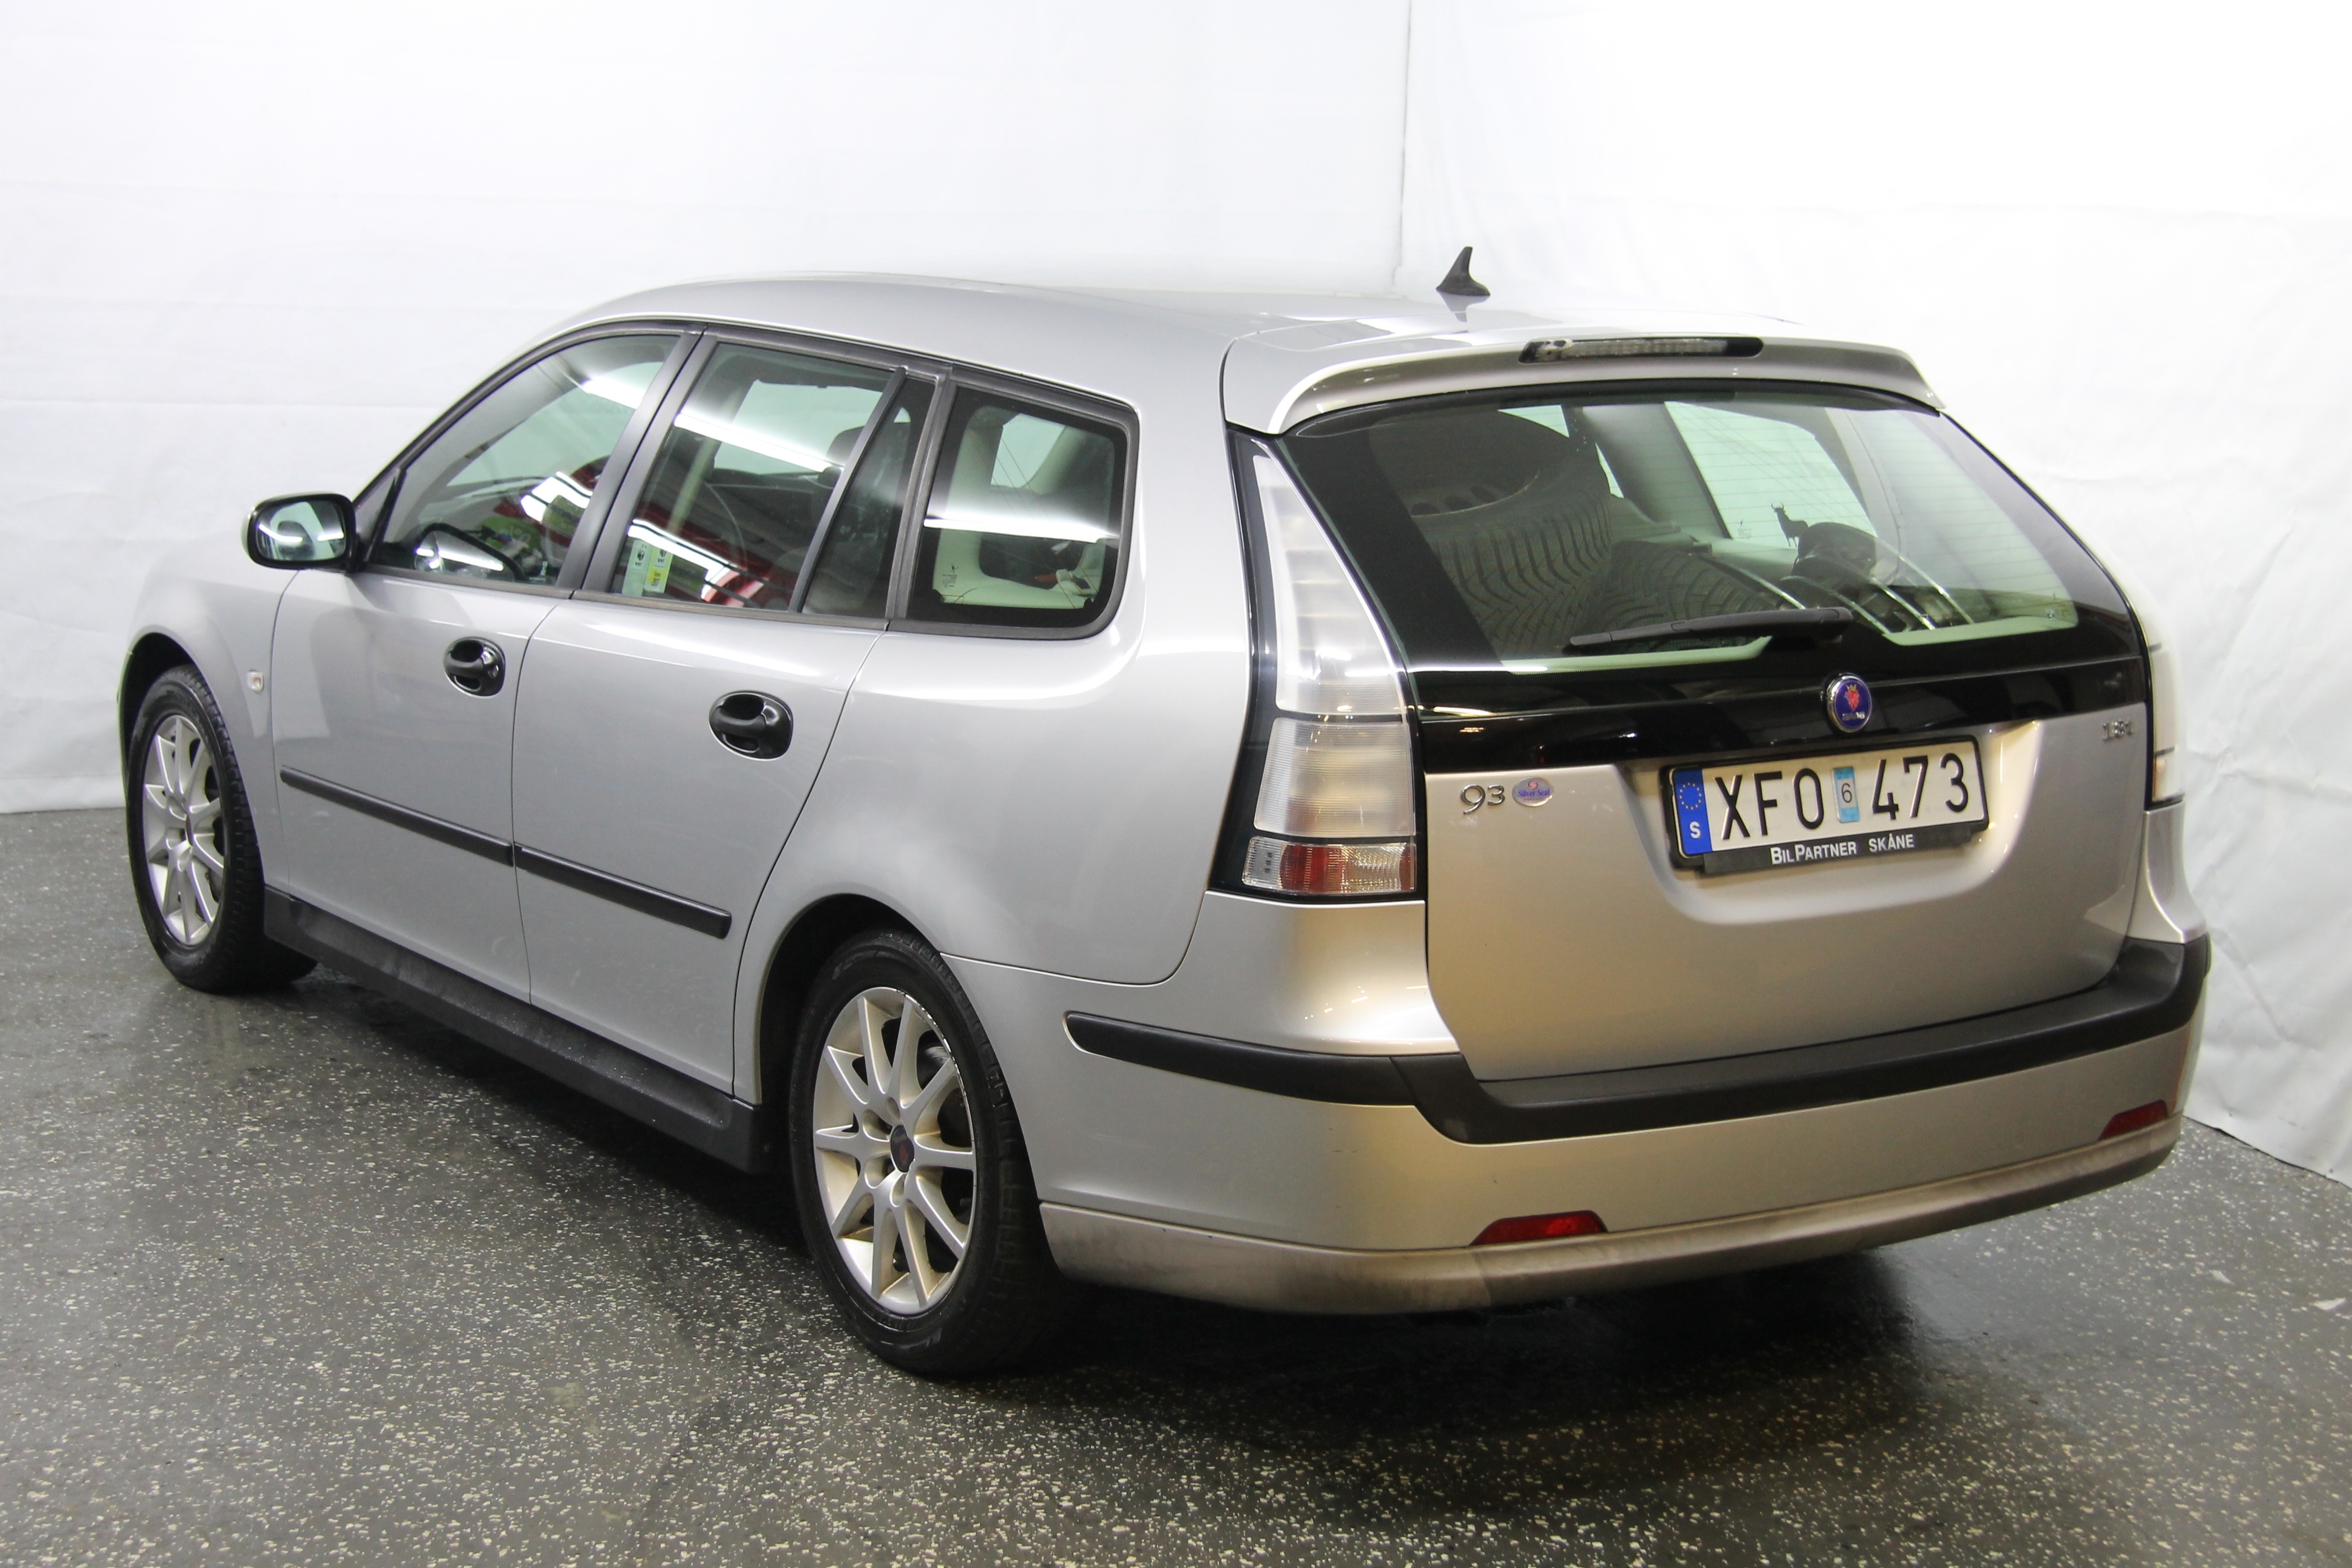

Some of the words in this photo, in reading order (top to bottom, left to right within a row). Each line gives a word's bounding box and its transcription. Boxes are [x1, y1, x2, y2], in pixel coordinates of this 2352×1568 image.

[1715, 767, 1825, 840] XFO
[1872, 753, 1968, 820] 473
[1842, 782, 1852, 803] 6
[1690, 821, 1701, 839] S
[1868, 833, 1915, 852] SKÅNE
